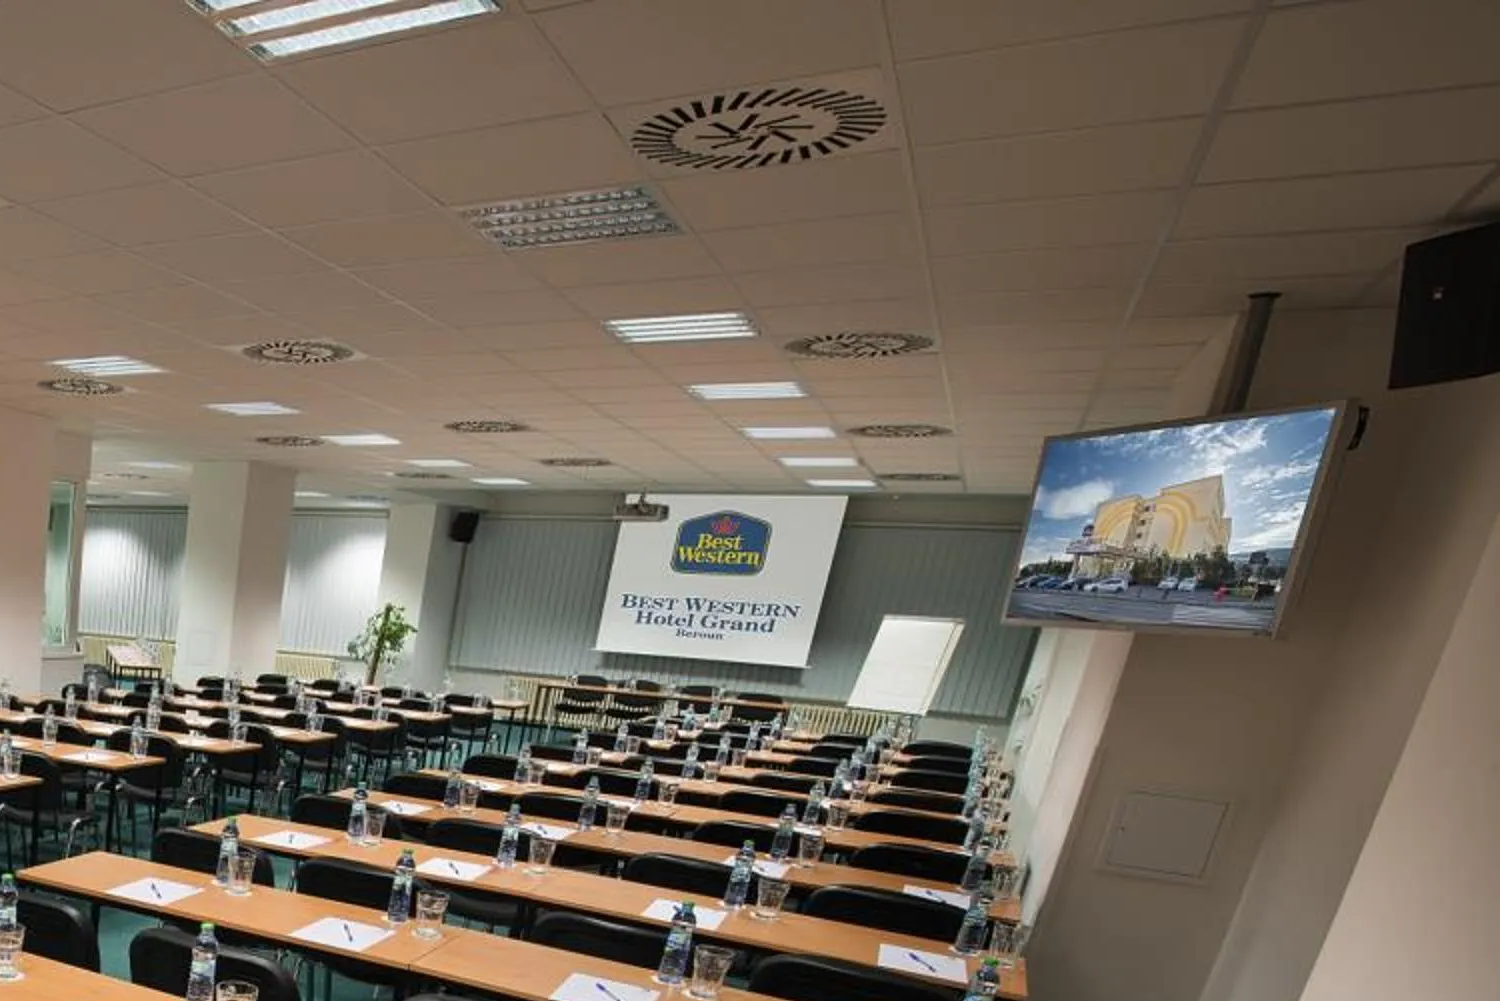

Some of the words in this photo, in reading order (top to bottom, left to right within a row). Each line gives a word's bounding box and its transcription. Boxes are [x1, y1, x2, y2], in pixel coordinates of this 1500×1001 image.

[699, 534, 744, 549] Best
[679, 547, 762, 565] Western
[621, 594, 678, 610] BEST
[685, 598, 801, 618] WESTERN
[635, 611, 694, 627] Hotel
[701, 615, 776, 633] Grand
